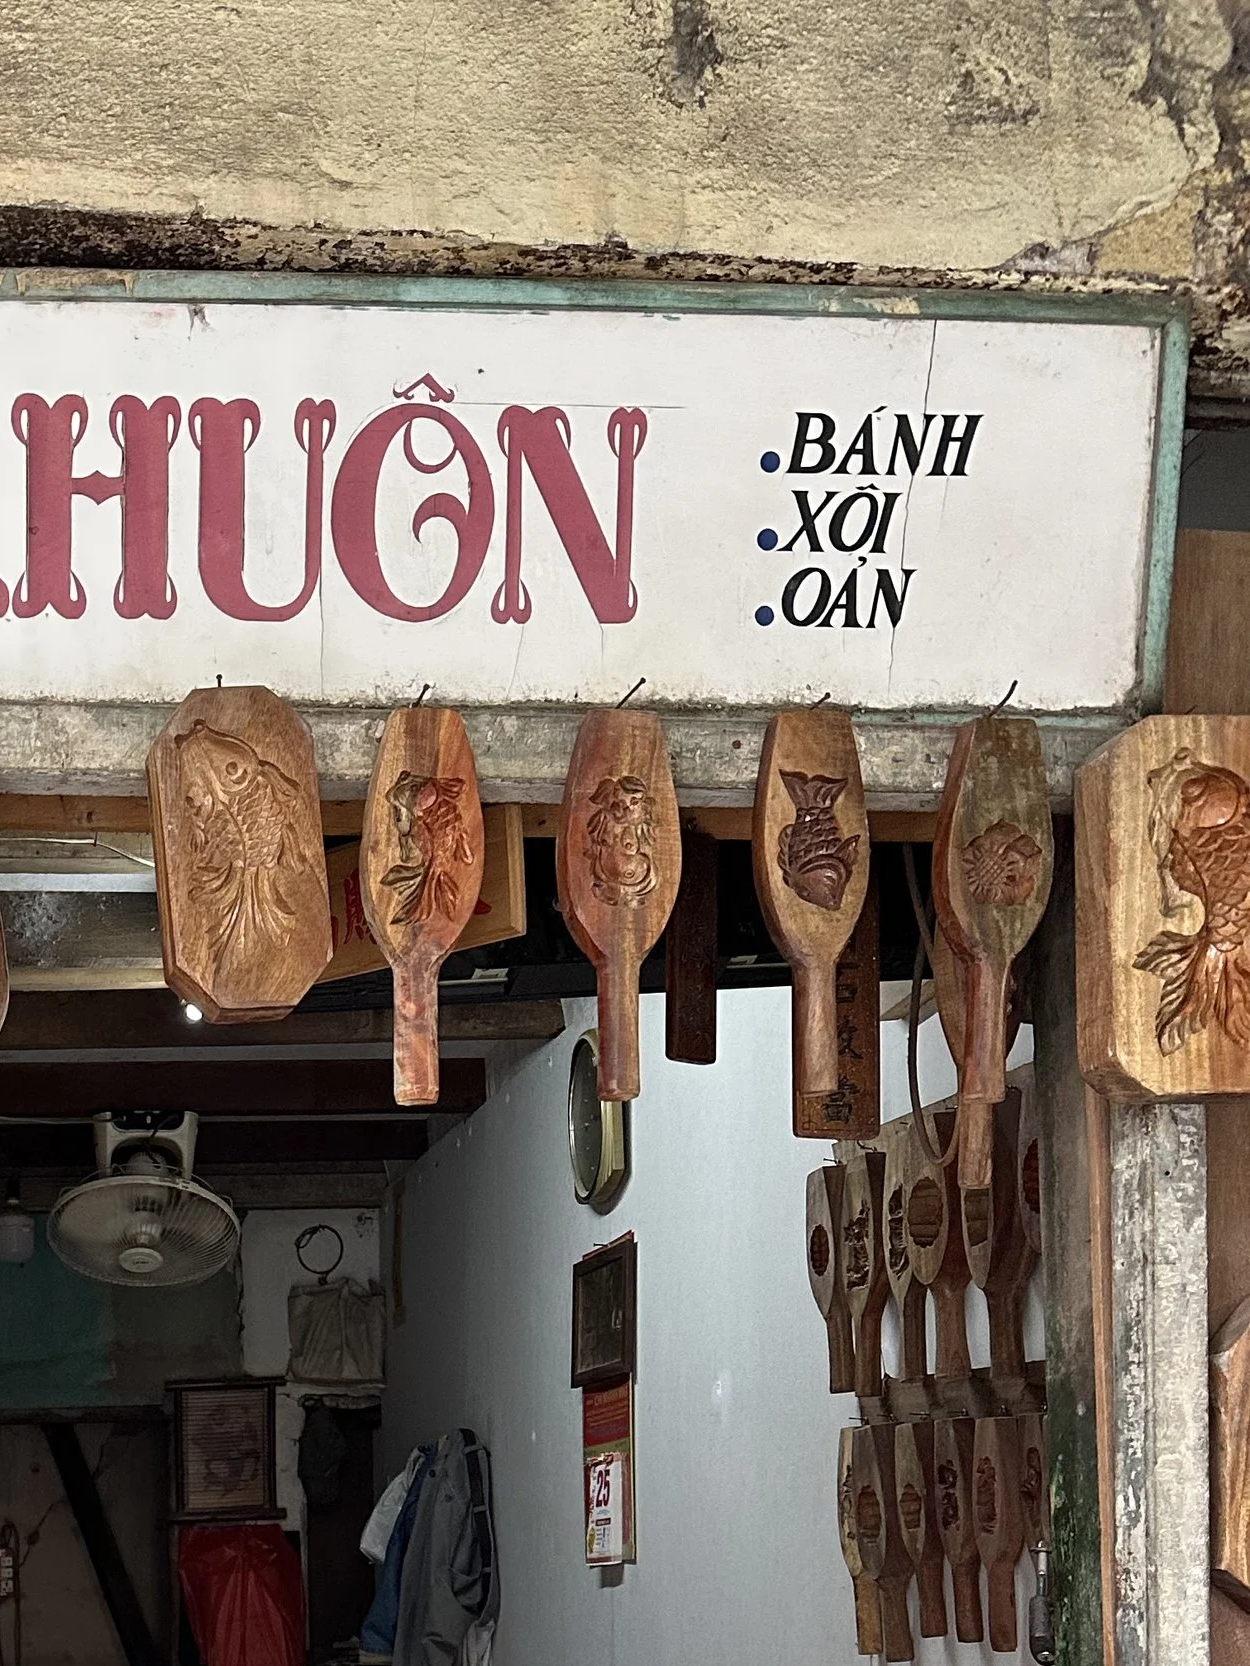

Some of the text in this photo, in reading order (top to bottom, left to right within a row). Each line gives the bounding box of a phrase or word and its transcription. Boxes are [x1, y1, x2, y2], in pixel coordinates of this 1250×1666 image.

[785, 406, 985, 476] BÁNH
[776, 483, 903, 553] XÔI
[781, 556, 918, 629] OẢN
[596, 1469, 610, 1508] 25
